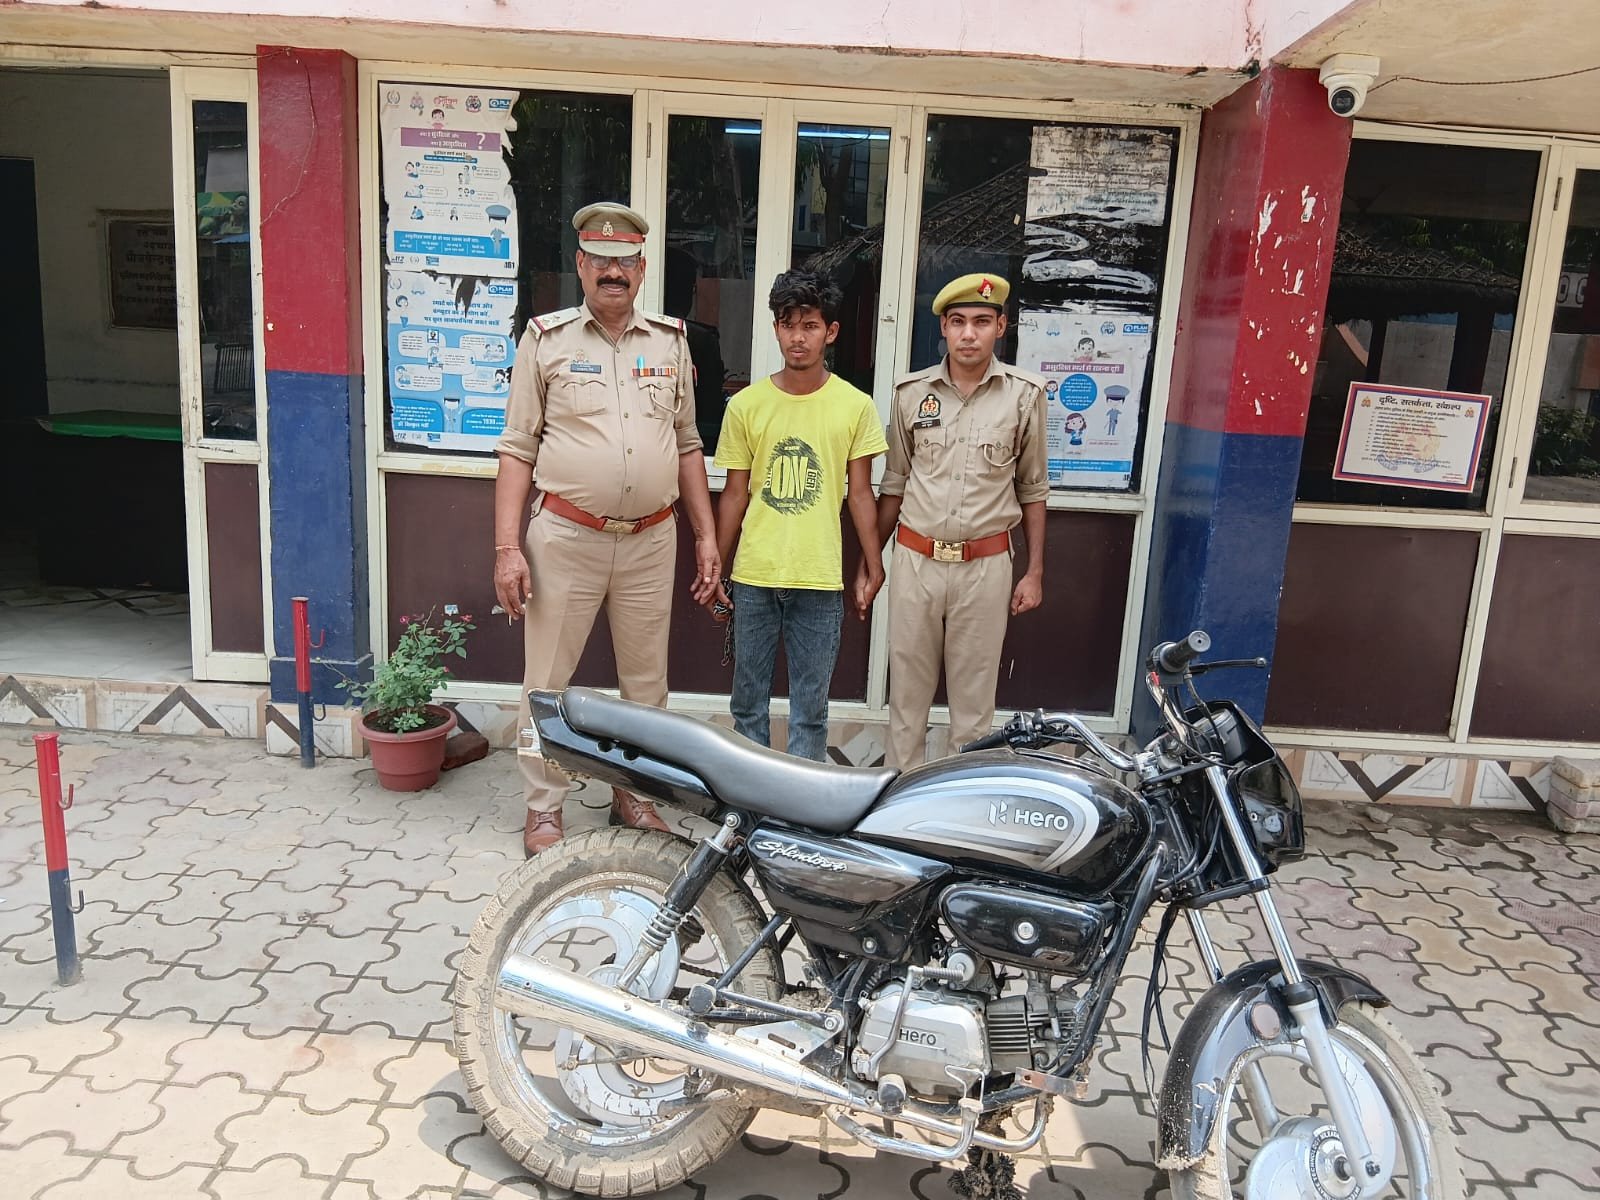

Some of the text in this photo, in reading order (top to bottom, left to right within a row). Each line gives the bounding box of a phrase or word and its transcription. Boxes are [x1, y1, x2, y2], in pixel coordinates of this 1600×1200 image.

[1401, 397, 1433, 409] सतर्कता,
[771, 455, 809, 499] ON
[1014, 808, 1069, 831] Hero
[899, 1028, 937, 1046] Hero
